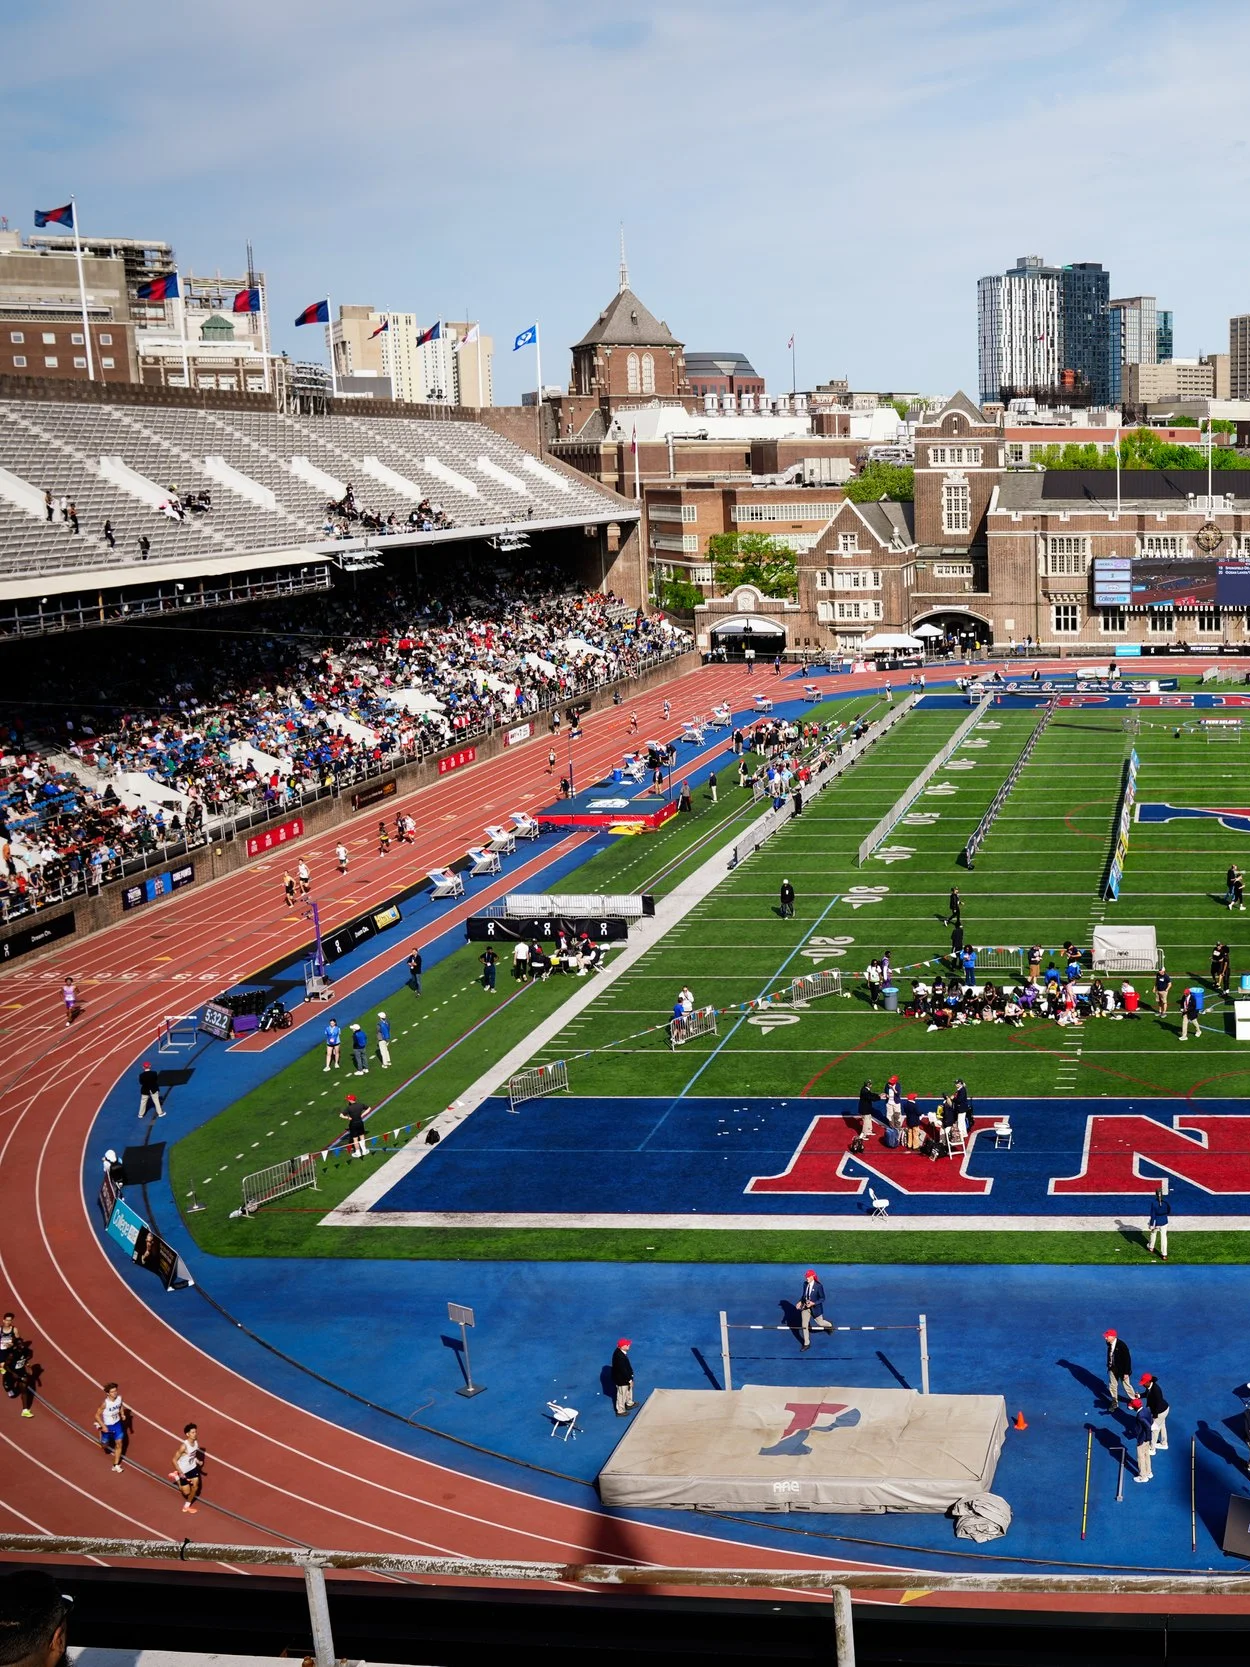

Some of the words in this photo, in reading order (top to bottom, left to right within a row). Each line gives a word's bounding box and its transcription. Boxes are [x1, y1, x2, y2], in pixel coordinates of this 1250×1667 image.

[1141, 549, 1194, 558] FRANKLIN
[31, 931, 44, 943] Dream
[799, 936, 855, 958] 20
[204, 1008, 229, 1029] 5:32.2
[112, 1208, 132, 1237] College
